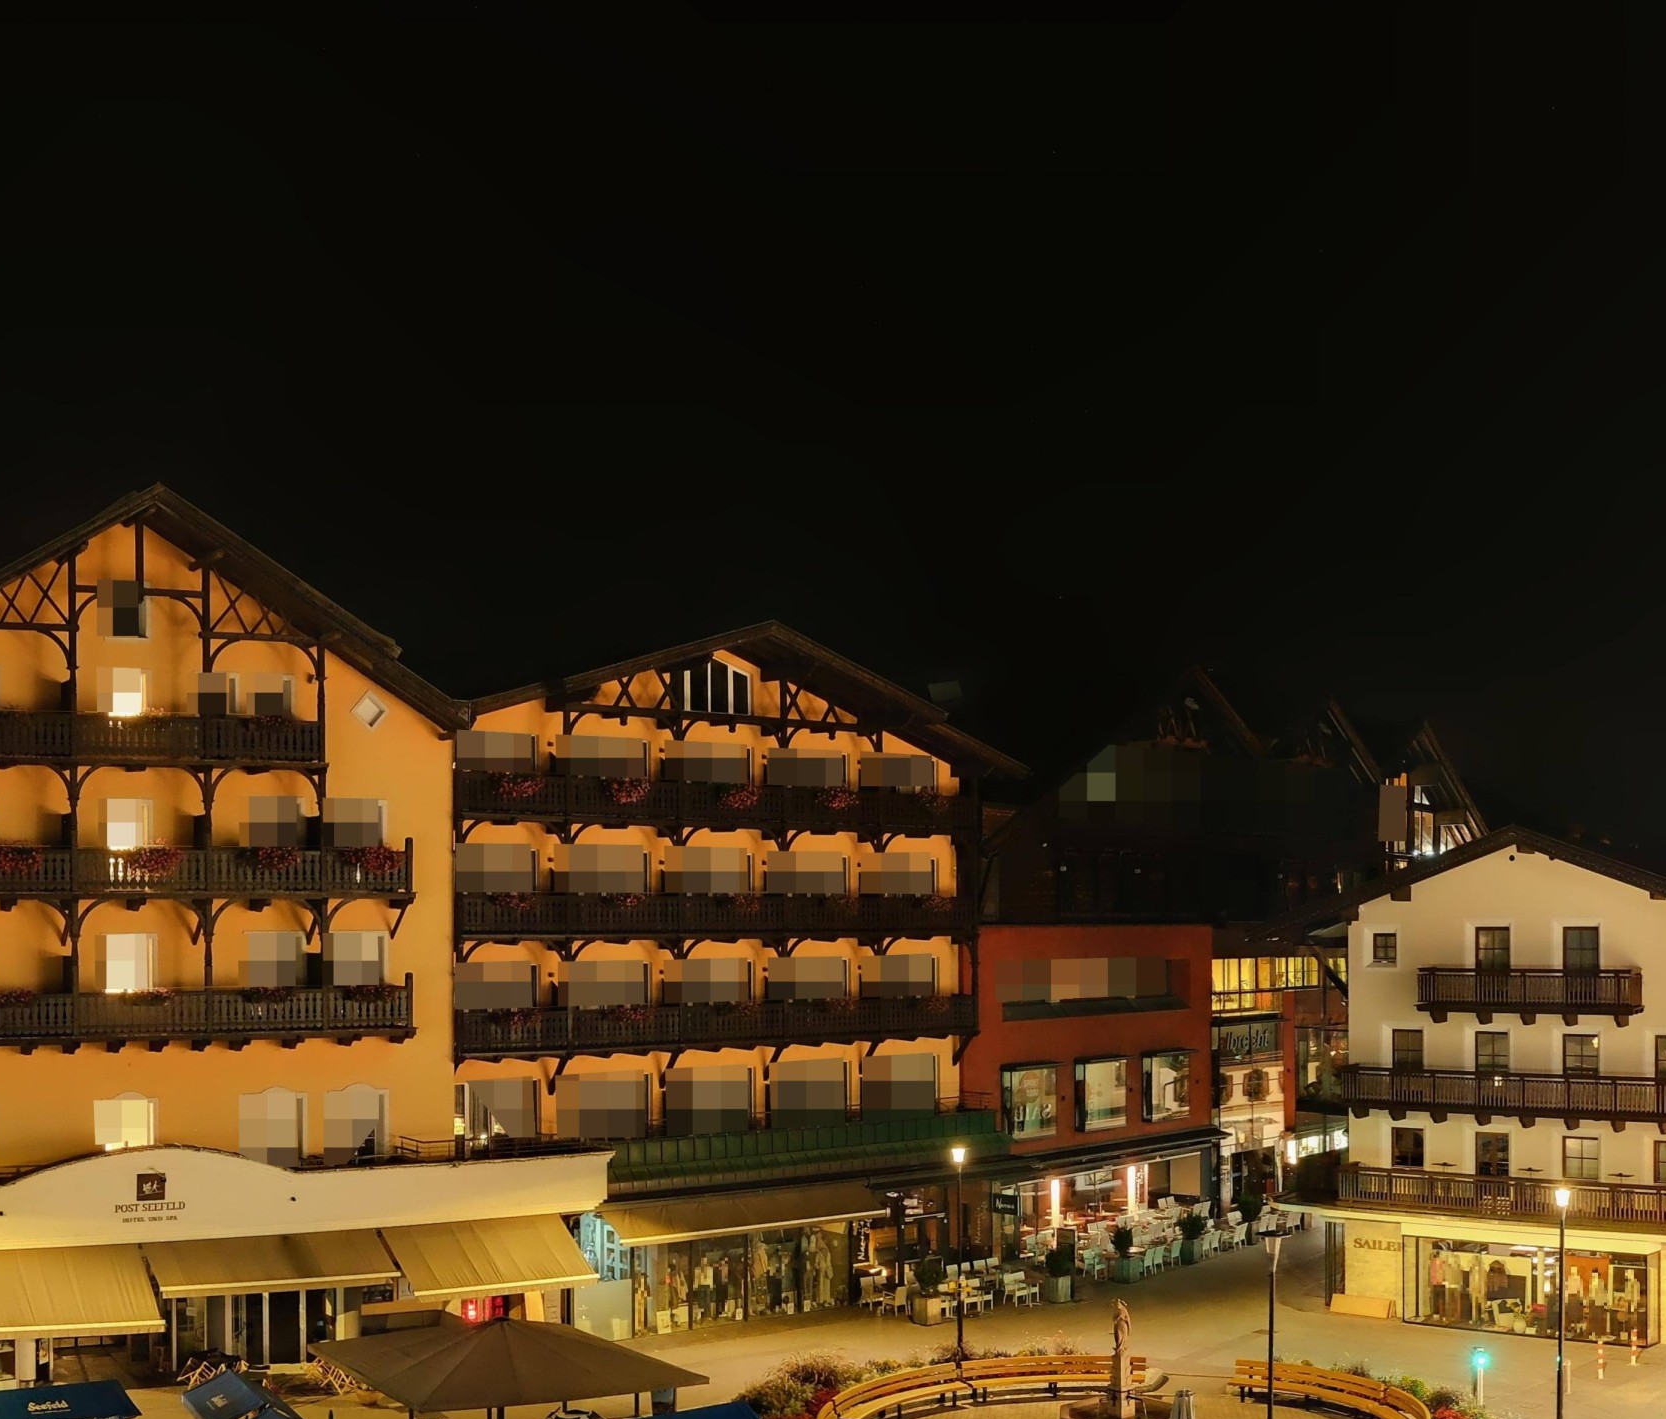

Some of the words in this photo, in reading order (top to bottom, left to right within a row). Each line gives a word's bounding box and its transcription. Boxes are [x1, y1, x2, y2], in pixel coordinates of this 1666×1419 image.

[1220, 1027, 1269, 1053] lbrecht
[114, 1203, 140, 1213] POST
[141, 1201, 186, 1212] SEEFELD
[27, 1399, 69, 1412] Seefeld
